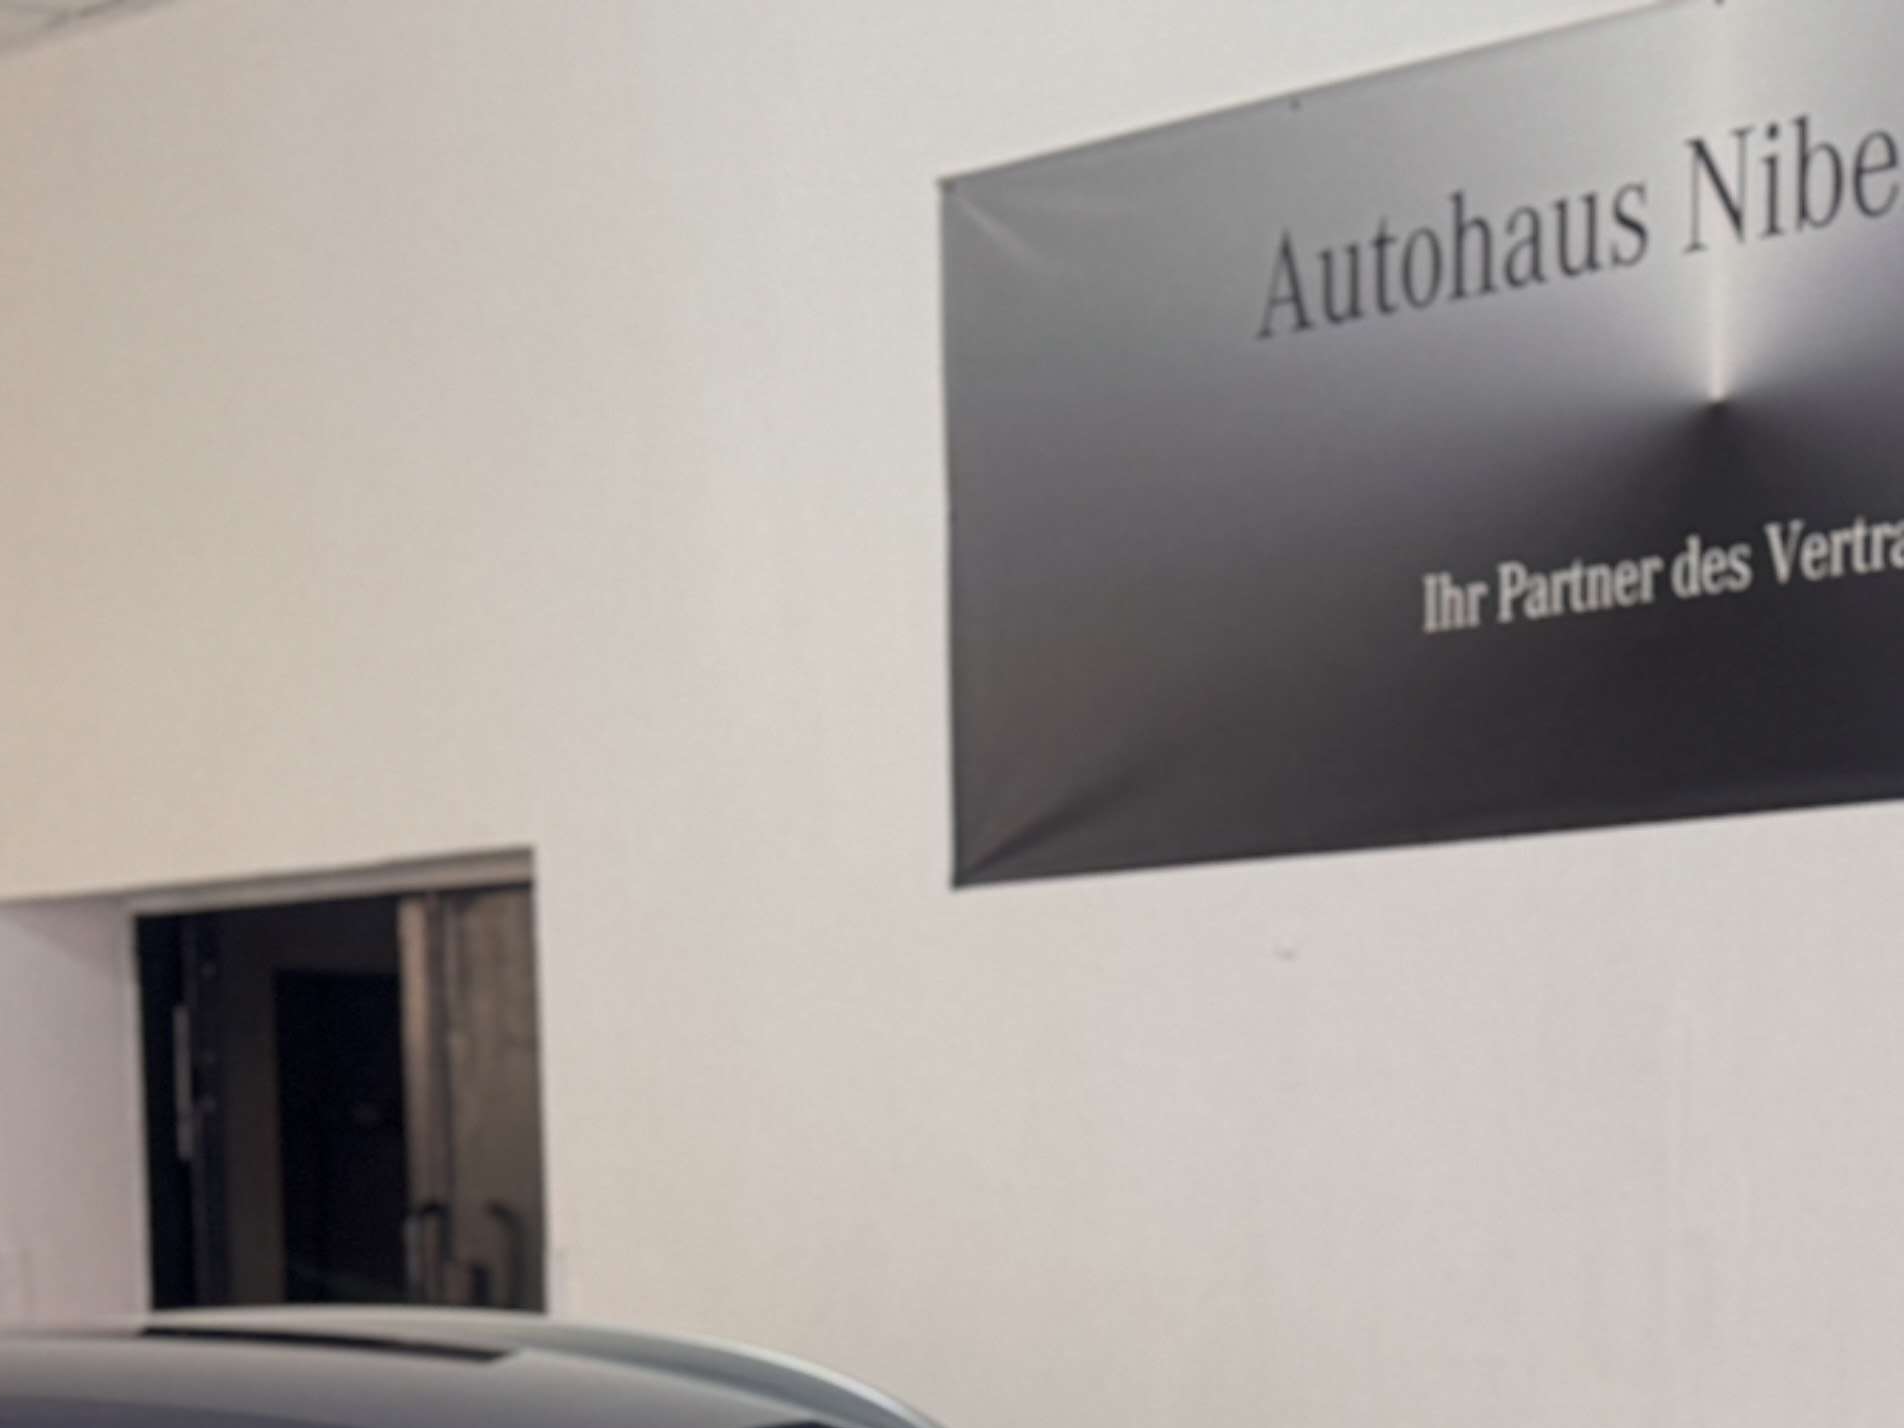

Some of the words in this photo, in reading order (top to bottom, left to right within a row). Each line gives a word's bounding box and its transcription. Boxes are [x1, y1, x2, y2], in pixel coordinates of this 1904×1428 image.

[1254, 182, 1650, 341] Autohaus
[1422, 571, 1490, 634] Ihr
[1496, 554, 1664, 623] Partner
[1671, 534, 1753, 599] des
